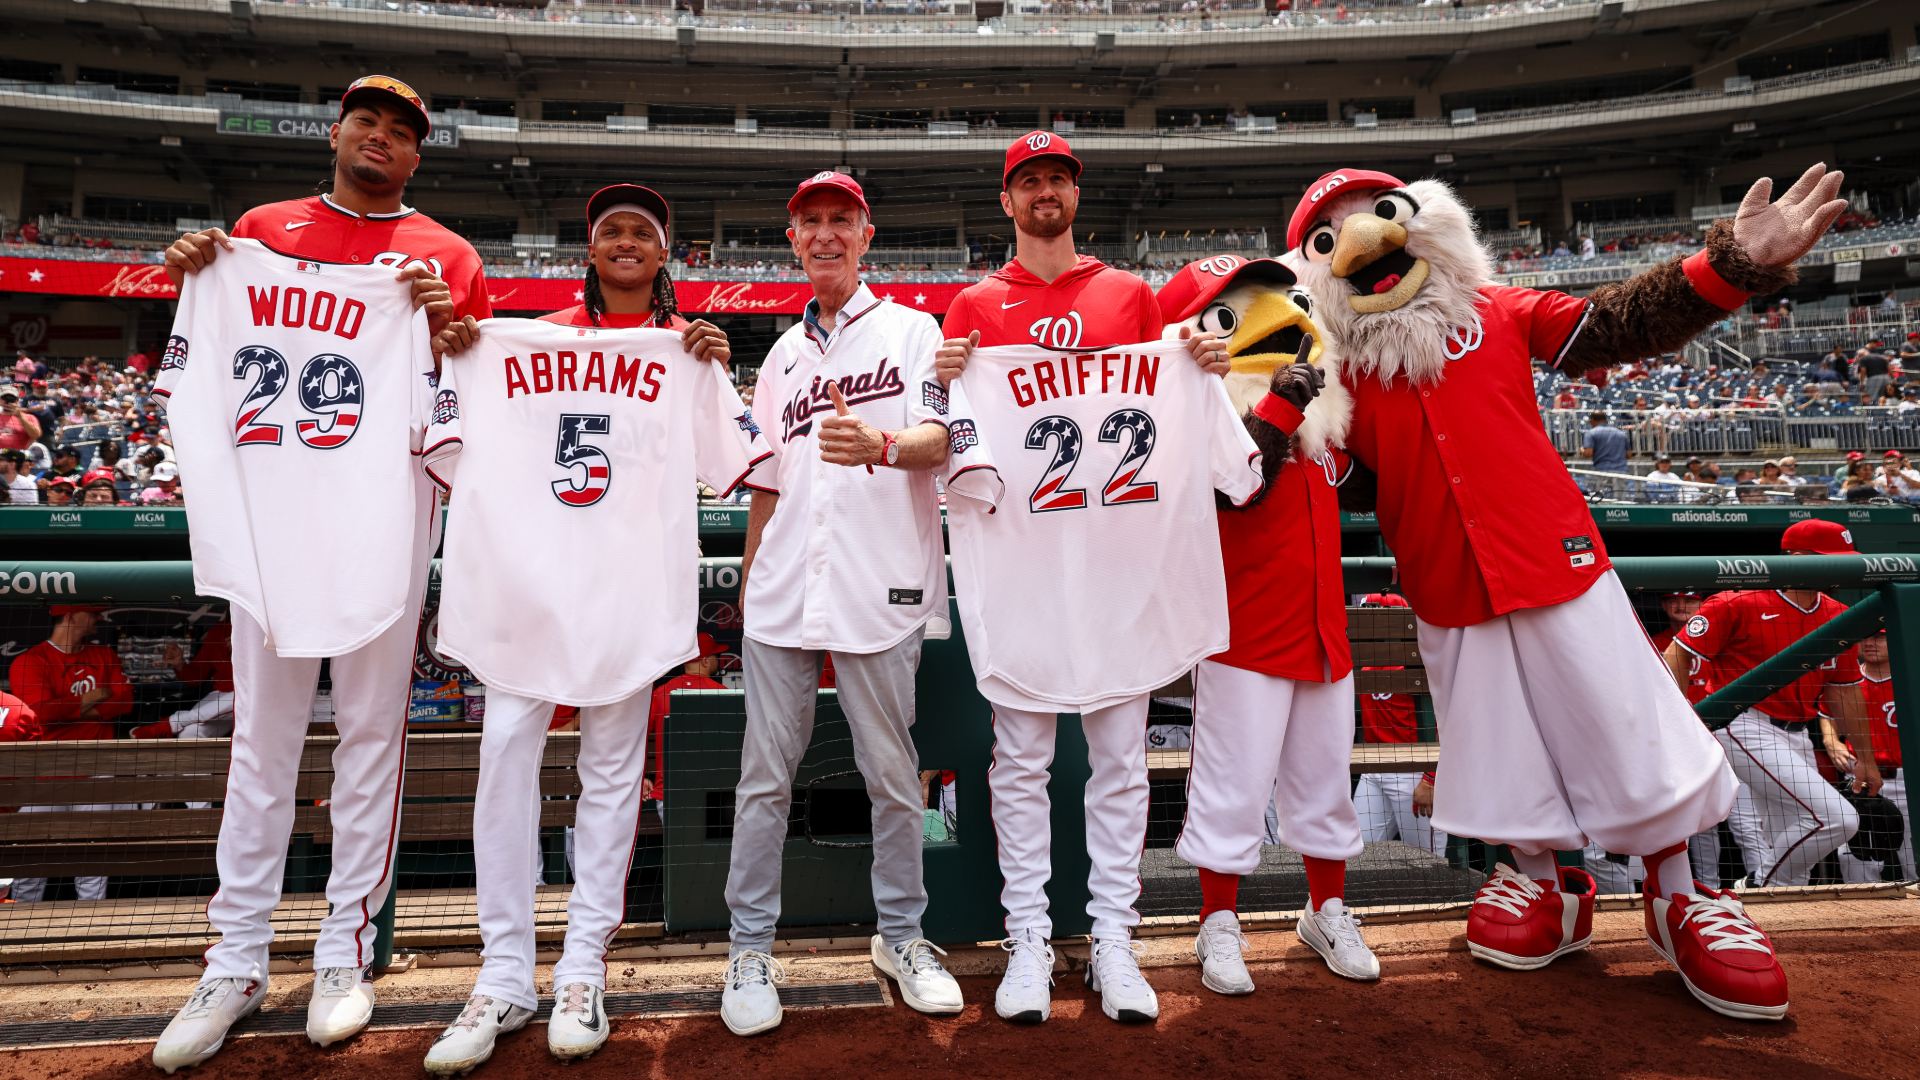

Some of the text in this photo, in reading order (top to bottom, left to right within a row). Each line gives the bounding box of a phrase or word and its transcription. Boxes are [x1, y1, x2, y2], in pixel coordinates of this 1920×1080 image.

[247, 285, 367, 340] WOOD
[167, 338, 187, 353] SA
[162, 353, 186, 369] 50
[504, 351, 667, 403] ABRAMS
[1008, 353, 1160, 408] GRIFFIN
[233, 344, 365, 450] 29
[551, 413, 612, 508] 5
[1024, 408, 1159, 514] 22
[50, 513, 81, 522] MGM
[134, 513, 165, 522] MGM
[702, 512, 730, 521] MGM
[1672, 510, 1748, 522] nationals.com
[1789, 510, 1812, 518] MGM
[1848, 510, 1870, 518] MGM
[1716, 559, 1770, 575] MGM
[1862, 556, 1918, 572] MGM
[0, 571, 77, 594] com
[416, 653, 474, 682] NATION
[408, 706, 438, 720] GIANTS
